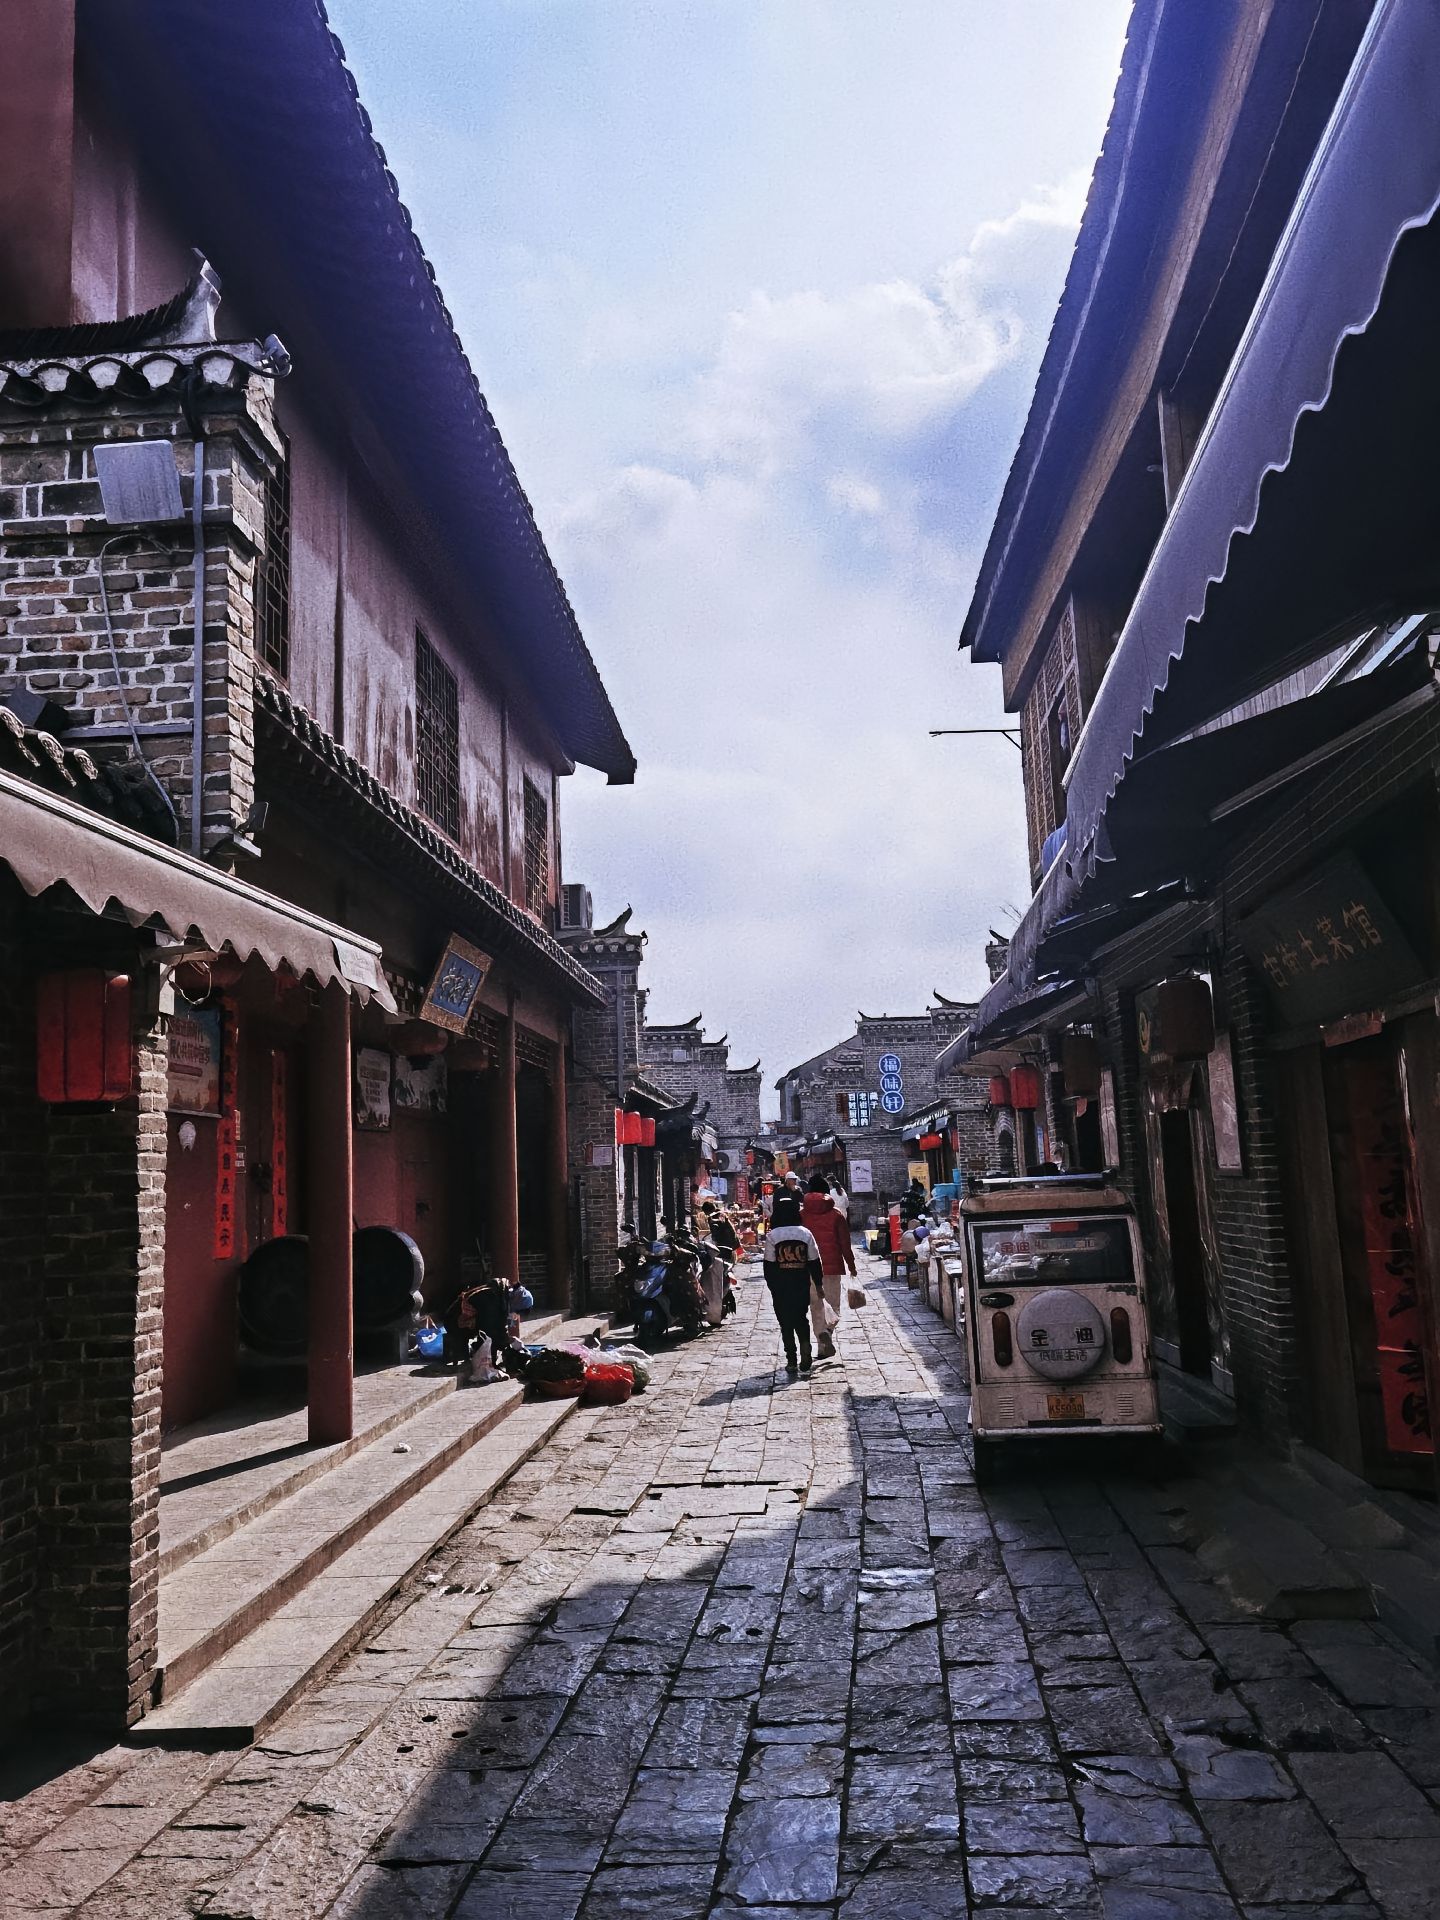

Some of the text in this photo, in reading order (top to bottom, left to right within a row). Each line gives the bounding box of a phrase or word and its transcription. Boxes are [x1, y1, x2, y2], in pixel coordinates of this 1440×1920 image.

[883, 1057, 900, 1110] 福味轩
[859, 1092, 869, 1127] 老街里的
[1031, 1327, 1095, 1347] 金 迪
